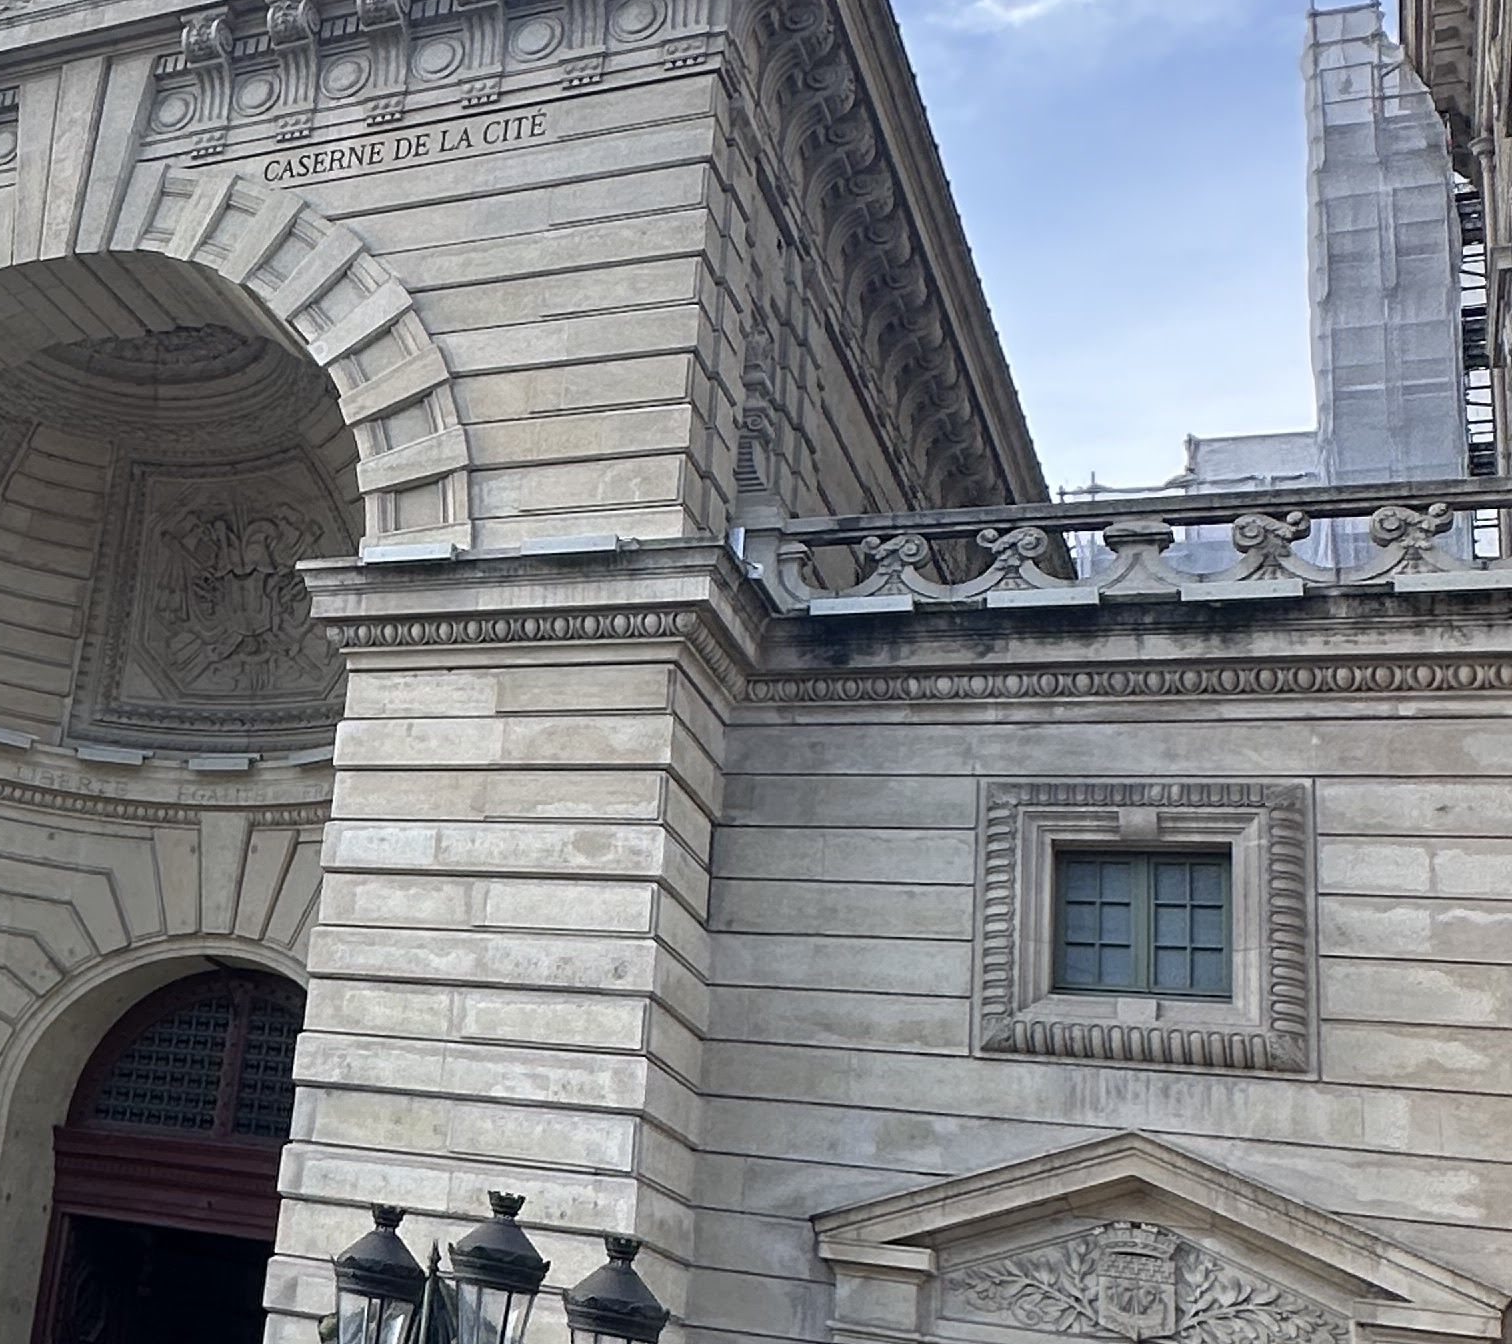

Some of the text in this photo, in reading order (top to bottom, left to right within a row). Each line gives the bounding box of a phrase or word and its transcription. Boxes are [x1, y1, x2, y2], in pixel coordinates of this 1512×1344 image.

[264, 108, 547, 182] CASERNE DE LA CITÉ
